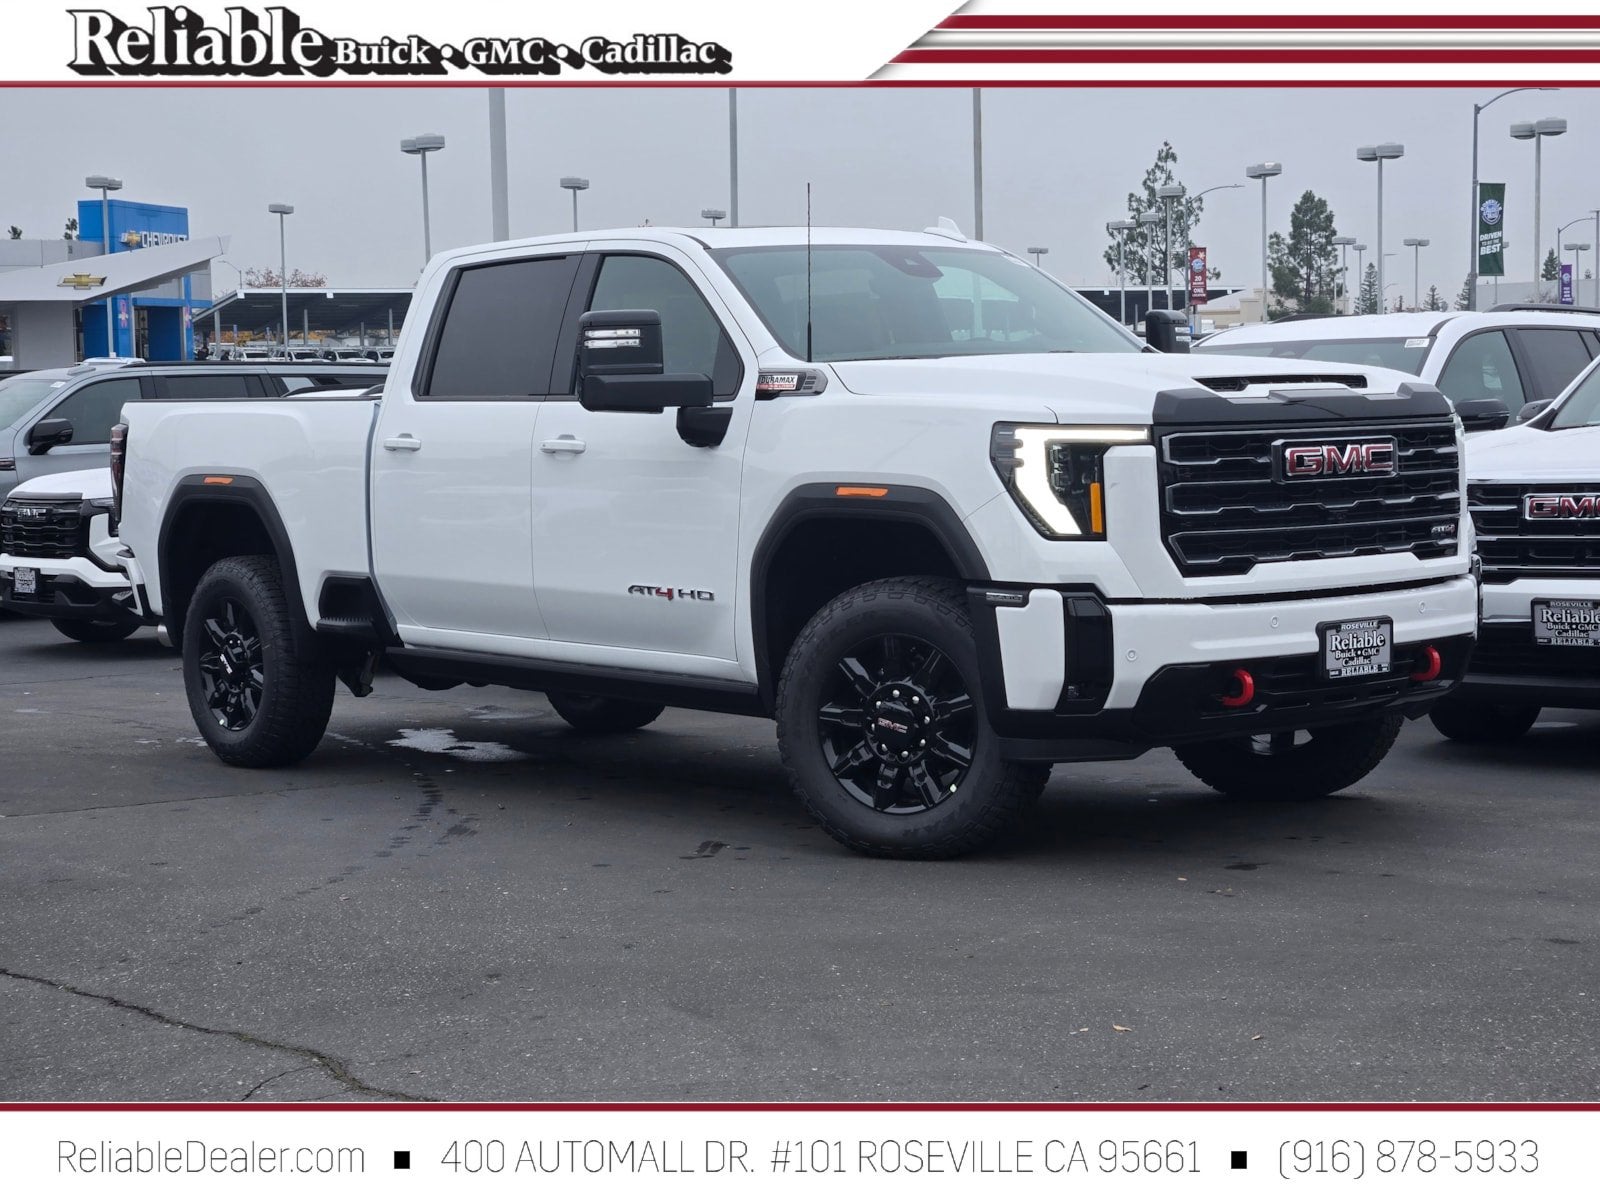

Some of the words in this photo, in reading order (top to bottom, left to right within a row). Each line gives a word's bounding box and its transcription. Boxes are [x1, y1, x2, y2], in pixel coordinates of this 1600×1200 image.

[1480, 244, 1501, 255] BEST
[760, 376, 795, 384] DURAMAX
[1285, 443, 1394, 477] GMC
[1529, 497, 1600, 518] GM
[628, 584, 674, 601] AT4
[678, 588, 715, 602] HD
[1541, 608, 1600, 624] Reliable
[1341, 620, 1379, 631] ROSEVILLE
[1547, 622, 1571, 631] Buick
[1577, 623, 1599, 631] GMC
[1555, 629, 1589, 638] Cadillac
[1330, 630, 1386, 652] Reliable
[1550, 637, 1595, 646] RELIABLE
[1335, 648, 1357, 660] Buick
[1361, 647, 1380, 657] GMC
[1342, 656, 1372, 667] Cadillac
[1341, 664, 1379, 677] RELIABLE
